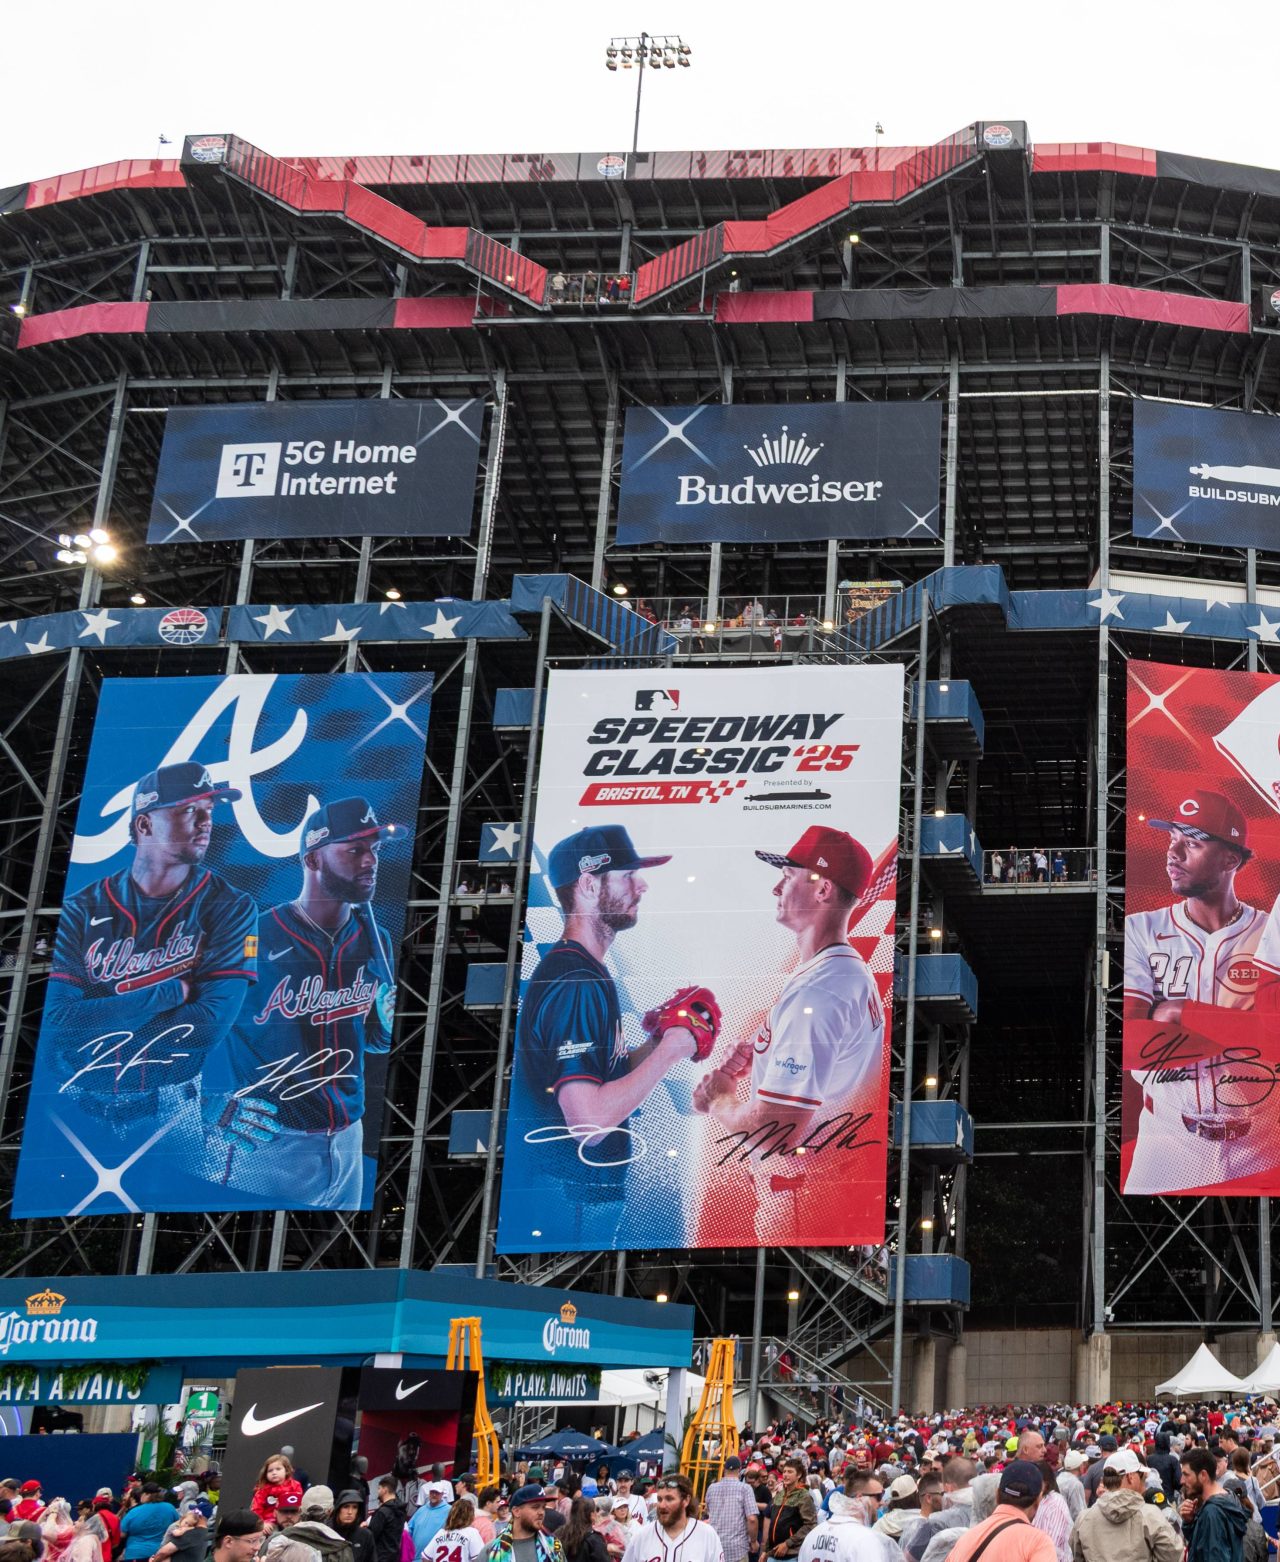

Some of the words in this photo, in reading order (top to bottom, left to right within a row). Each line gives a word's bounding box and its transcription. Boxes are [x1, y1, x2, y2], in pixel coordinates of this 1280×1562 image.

[284, 440, 325, 465] 5G
[332, 440, 417, 464] Home
[280, 471, 398, 496] Internet
[675, 474, 883, 505] Budweiser
[587, 713, 845, 745] SPEEDWAY
[583, 745, 791, 776] CLASSIC
[595, 785, 665, 801] BRISTOL,
[668, 786, 692, 799] TN
[763, 779, 803, 788] Presented
[803, 778, 813, 788] by
[742, 803, 832, 811] BUILDSUBMARINES.COM
[85, 921, 195, 984] Atlanta
[1149, 952, 1193, 998] 21
[1230, 968, 1260, 980] RED
[254, 964, 373, 1024] Atlanta
[0, 1311, 98, 1354] Corona
[543, 1318, 590, 1355] Corona
[514, 1373, 546, 1397] PLAYA
[549, 1374, 587, 1397] AWAITS
[199, 1392, 209, 1409] 1
[435, 1534, 469, 1544] PRIMETIME
